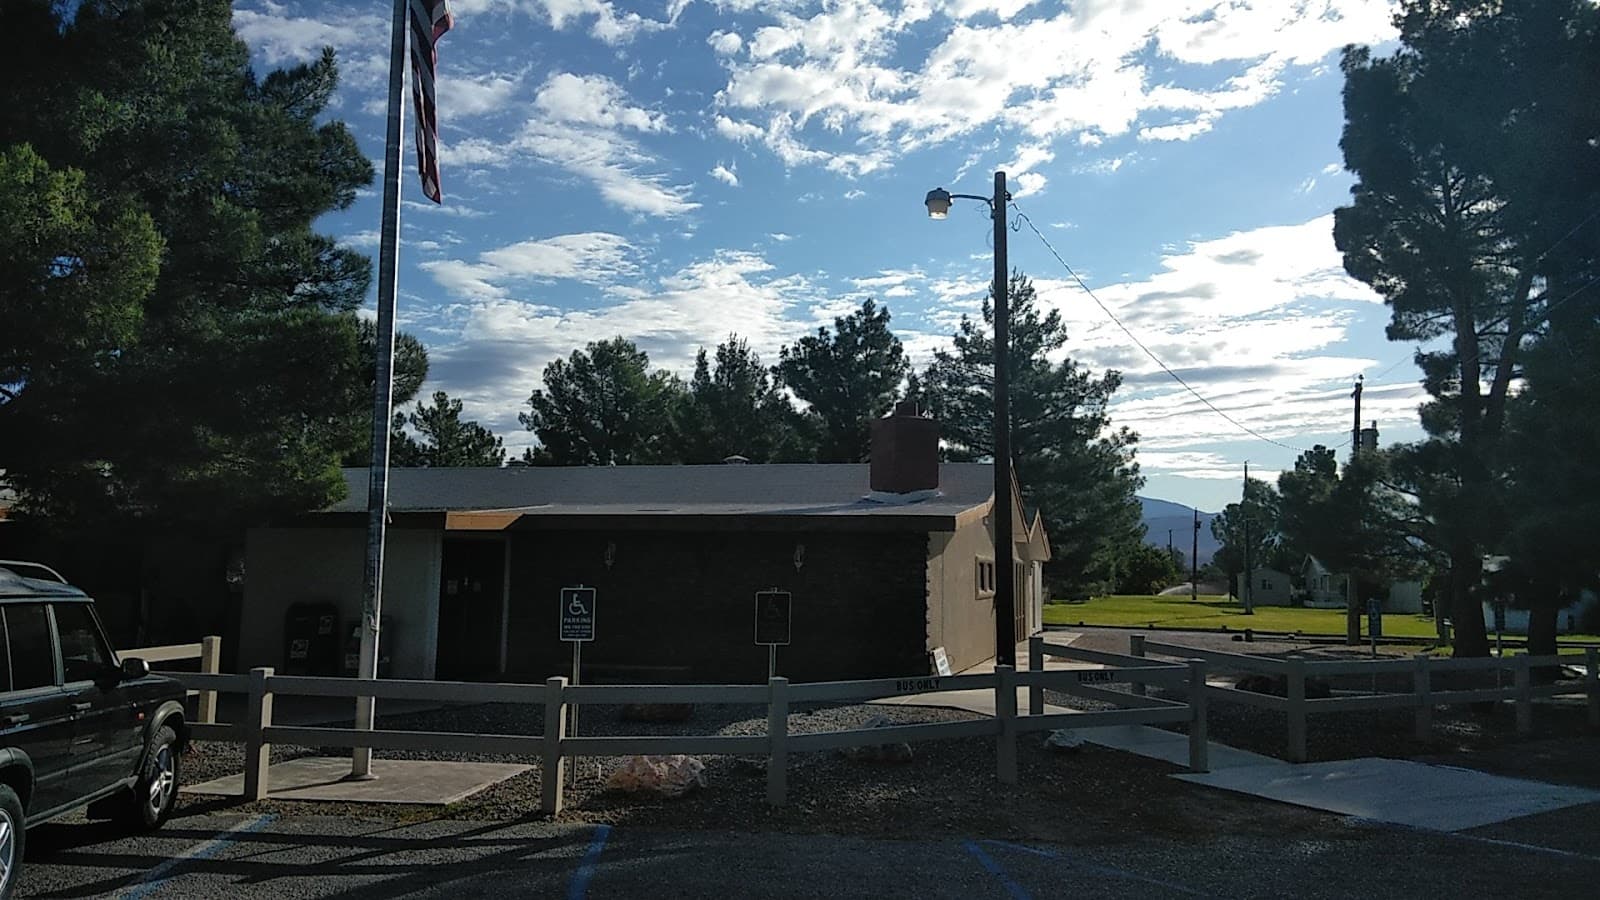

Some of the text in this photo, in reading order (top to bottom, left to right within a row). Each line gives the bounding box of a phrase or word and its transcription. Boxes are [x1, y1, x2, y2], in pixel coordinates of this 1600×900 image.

[1078, 671, 1114, 682] BUS ONLY
[896, 679, 940, 691] BUS ONLY
